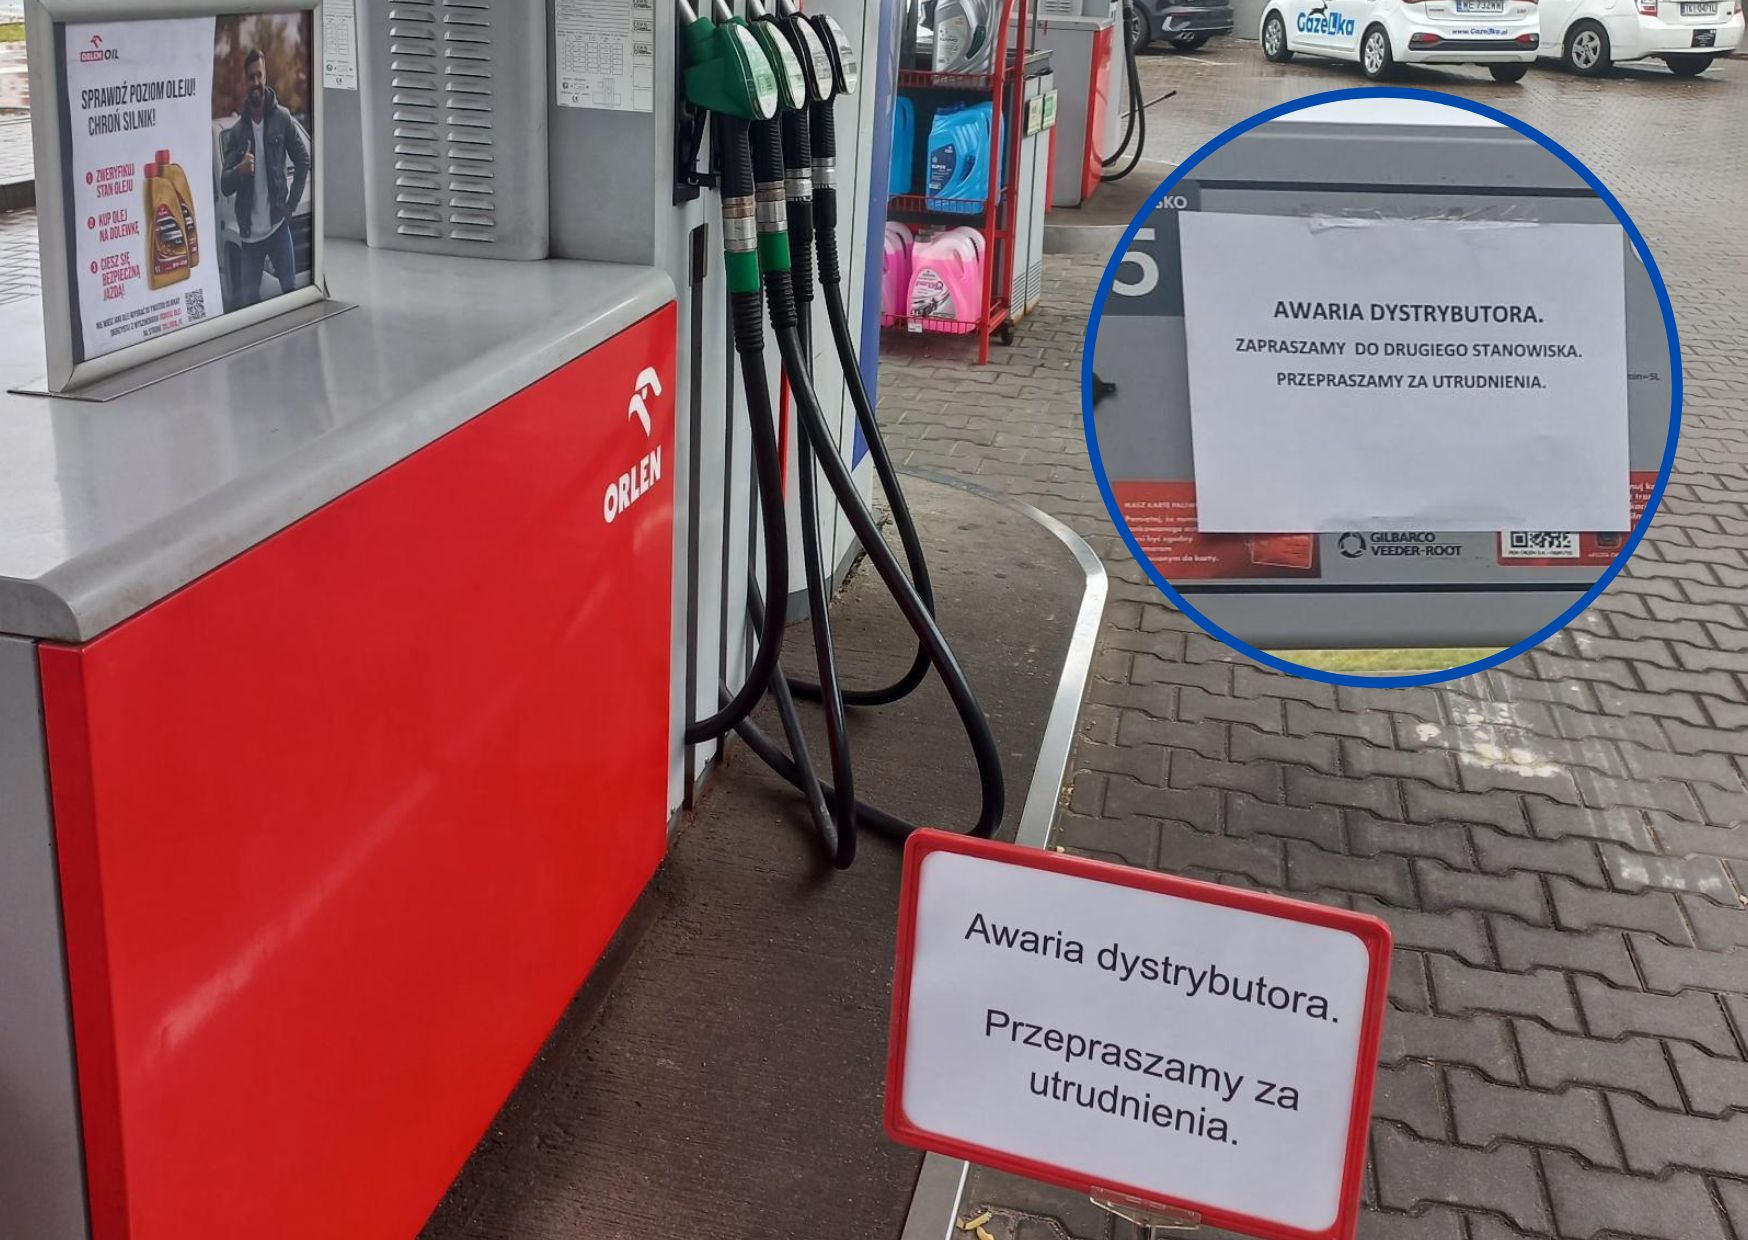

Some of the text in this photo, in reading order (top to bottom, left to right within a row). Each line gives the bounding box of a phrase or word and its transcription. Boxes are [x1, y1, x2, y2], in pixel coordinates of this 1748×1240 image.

[104, 49, 119, 60] OIL
[81, 78, 196, 110] SPRAWDŹ POZIOM OLEJU!
[88, 108, 156, 136] CHROŃ SILNIK!
[96, 183, 113, 198] STAN
[1112, 228, 1159, 297] 5
[1273, 300, 1544, 324] AWARIA DYSTRYBUTORA.
[1235, 338, 1582, 358] ZAPRASZAMY DO DRUGIEGO STANOWISKA.
[1277, 372, 1546, 389] PRZEPRASZAMY ZA UTRUDNIENIA.
[603, 444, 662, 524] ORLEN
[1370, 532, 1436, 543] GILBARCO
[1370, 545, 1462, 556] VEEDER-ROOT
[965, 912, 1338, 1023] Awaria dystrybutora.
[985, 1009, 1300, 1111] Przepraszamy za
[1029, 1071, 1238, 1145] utrudnienia.
